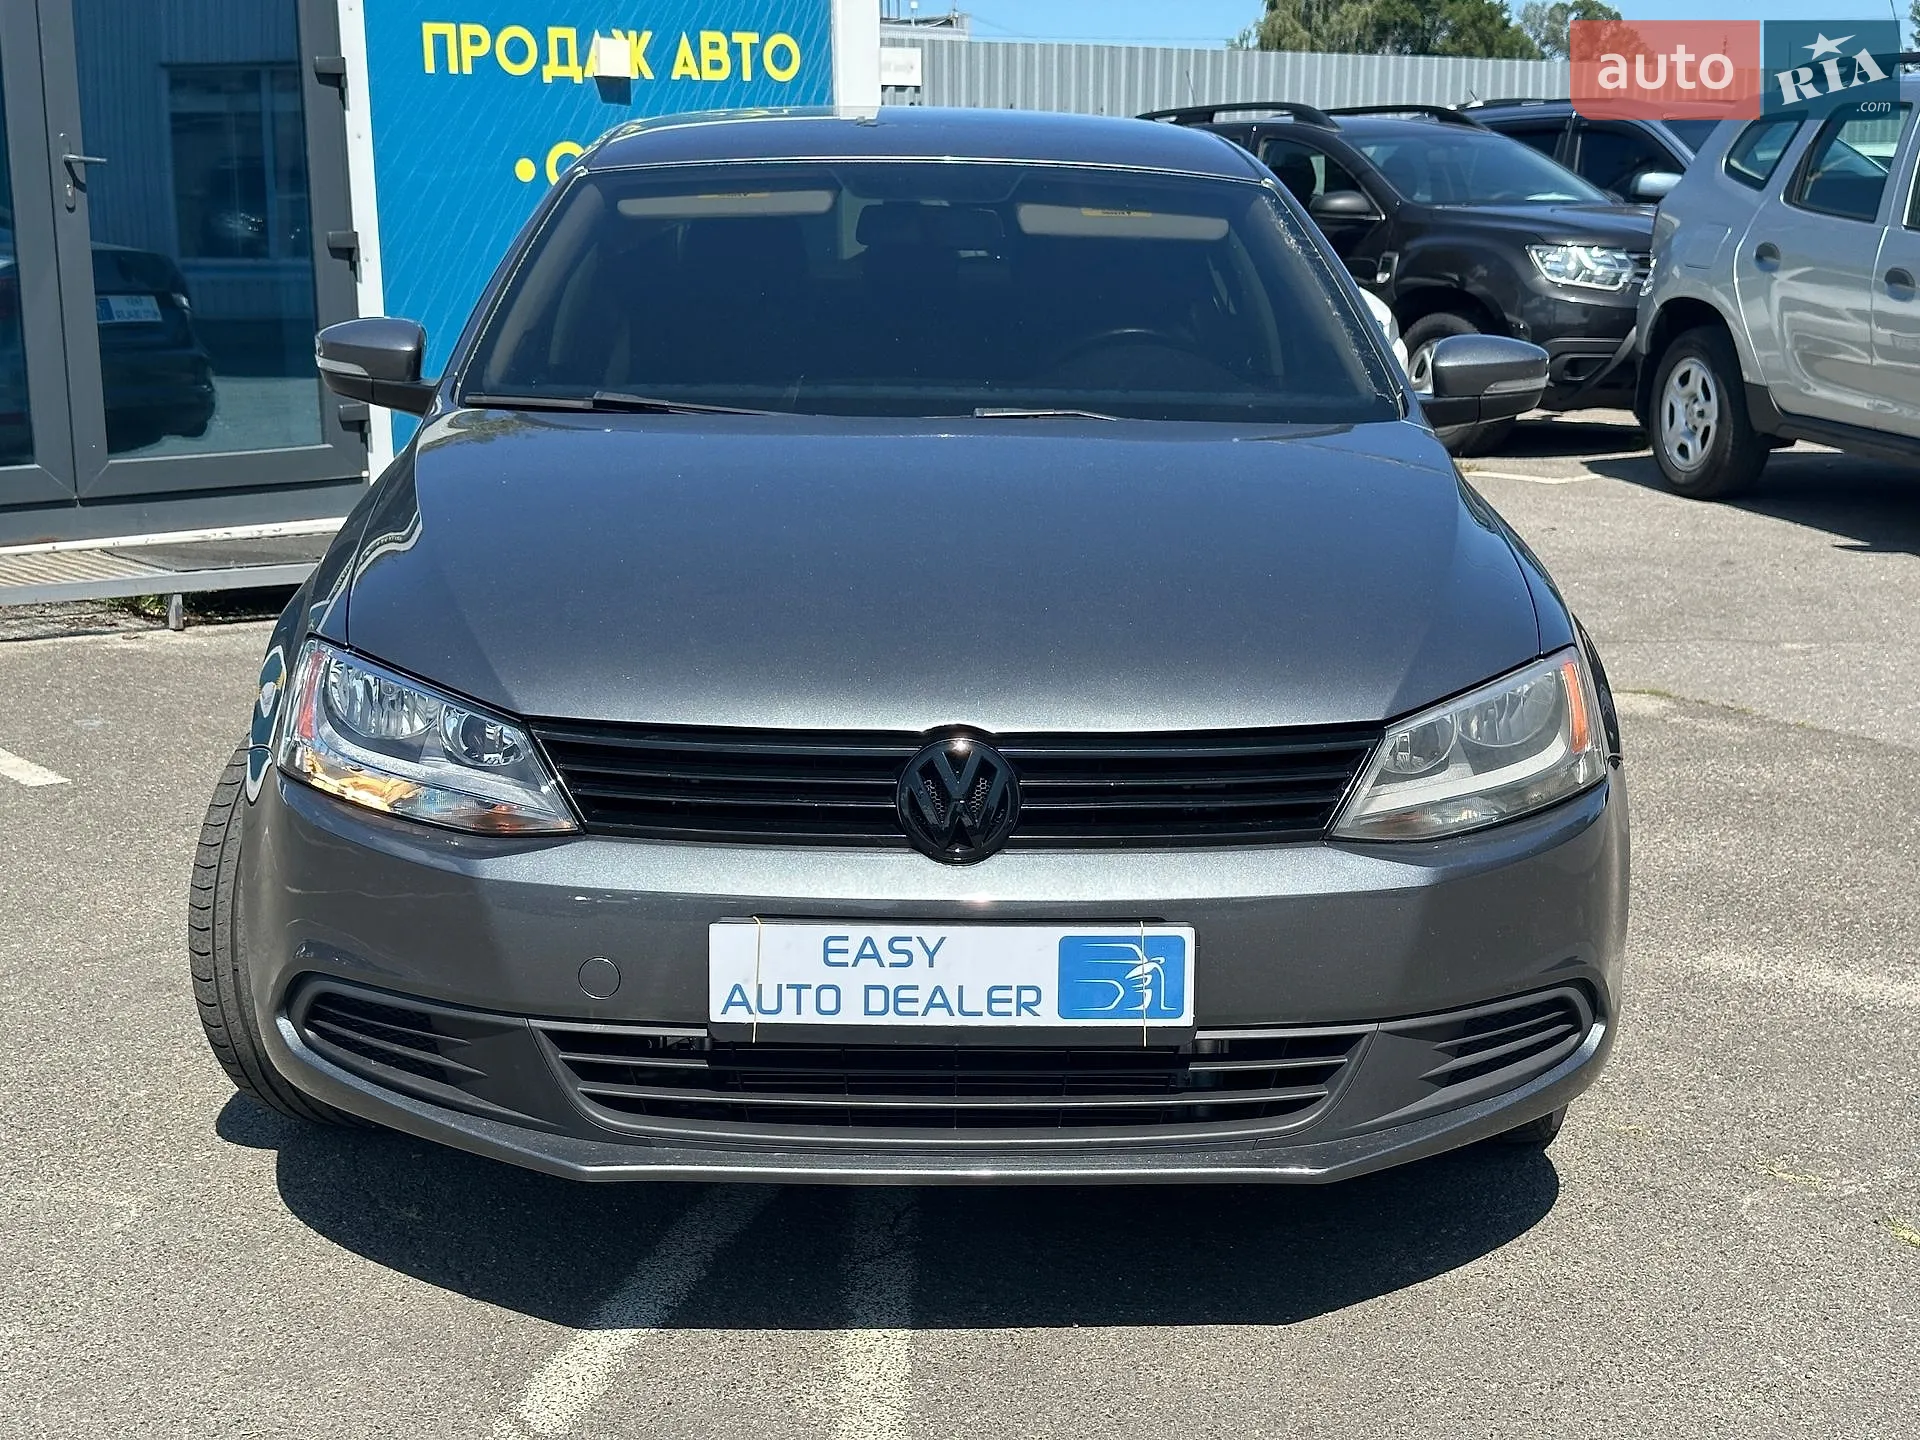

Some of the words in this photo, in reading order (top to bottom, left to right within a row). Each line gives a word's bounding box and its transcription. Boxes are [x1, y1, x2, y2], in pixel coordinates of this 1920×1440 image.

[670, 31, 801, 82] АВТО
[822, 935, 947, 969] EASY
[720, 982, 841, 1016] AUTO
[863, 984, 1042, 1017] DEALER
